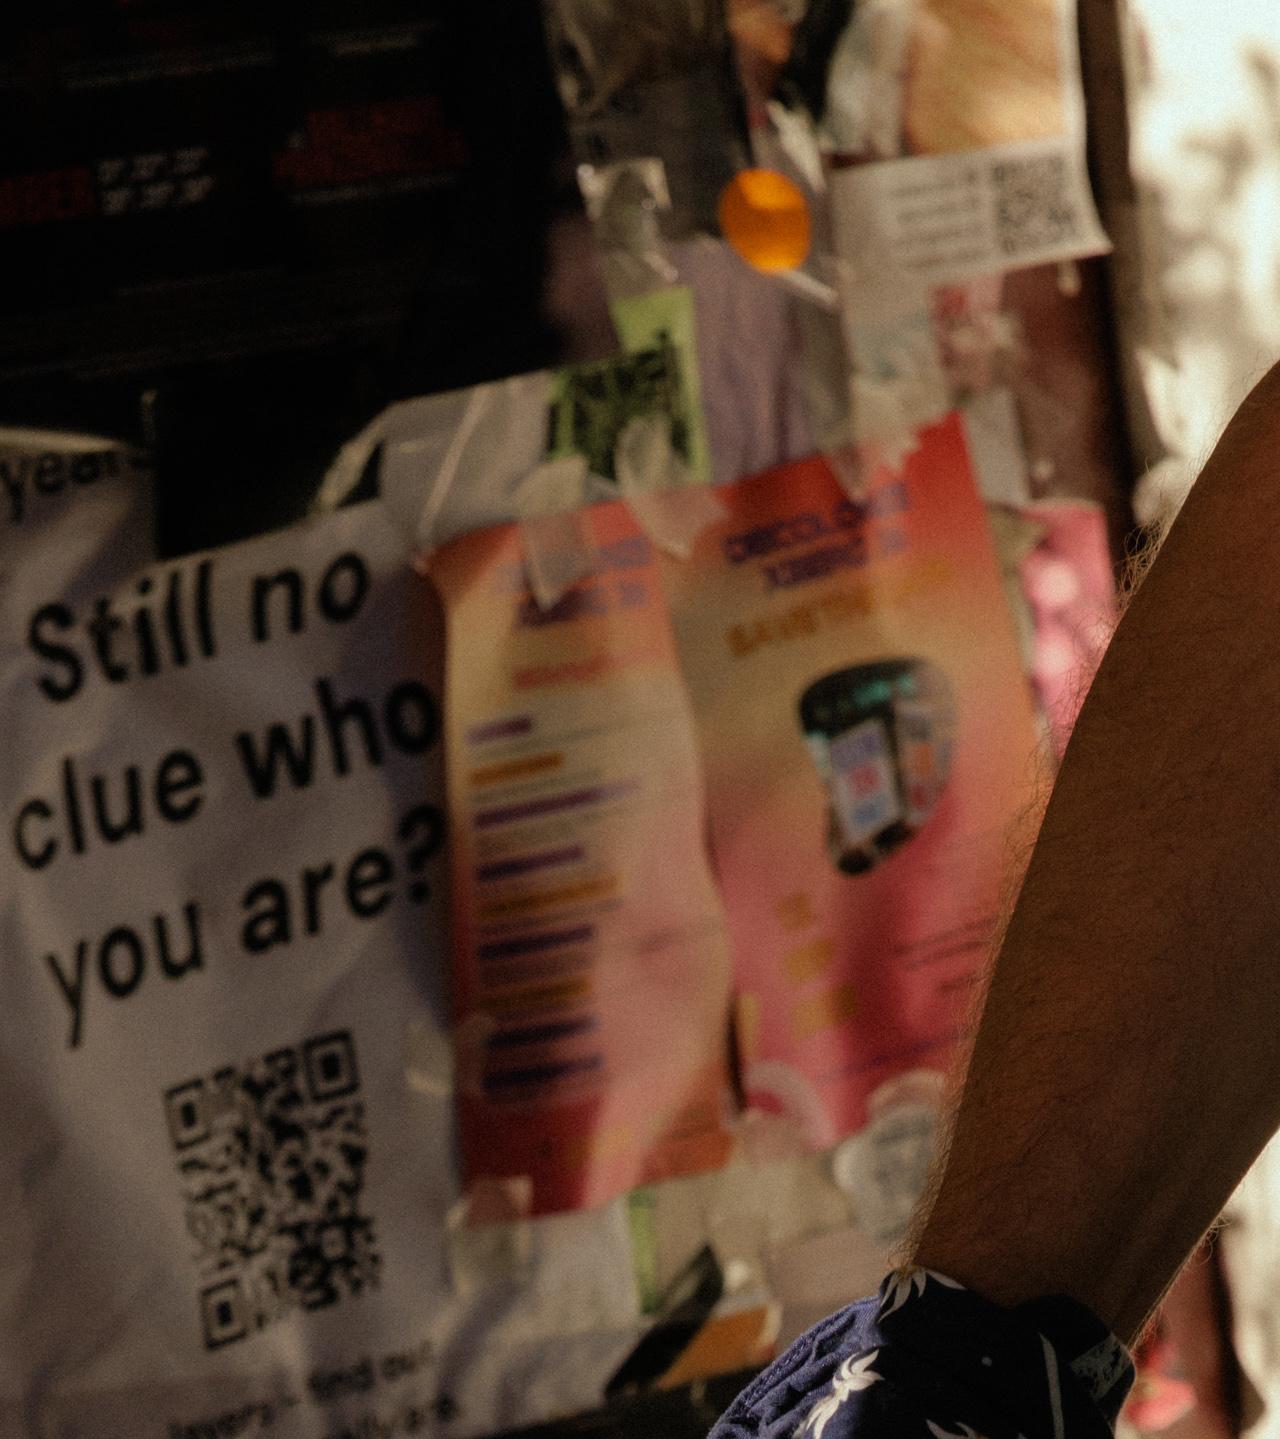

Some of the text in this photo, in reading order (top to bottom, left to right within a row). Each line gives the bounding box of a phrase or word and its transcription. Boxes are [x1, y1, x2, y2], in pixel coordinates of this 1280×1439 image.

[28, 559, 215, 702] Still
[252, 552, 369, 642] no
[14, 678, 441, 870] clue who
[45, 803, 444, 1050] you are?
